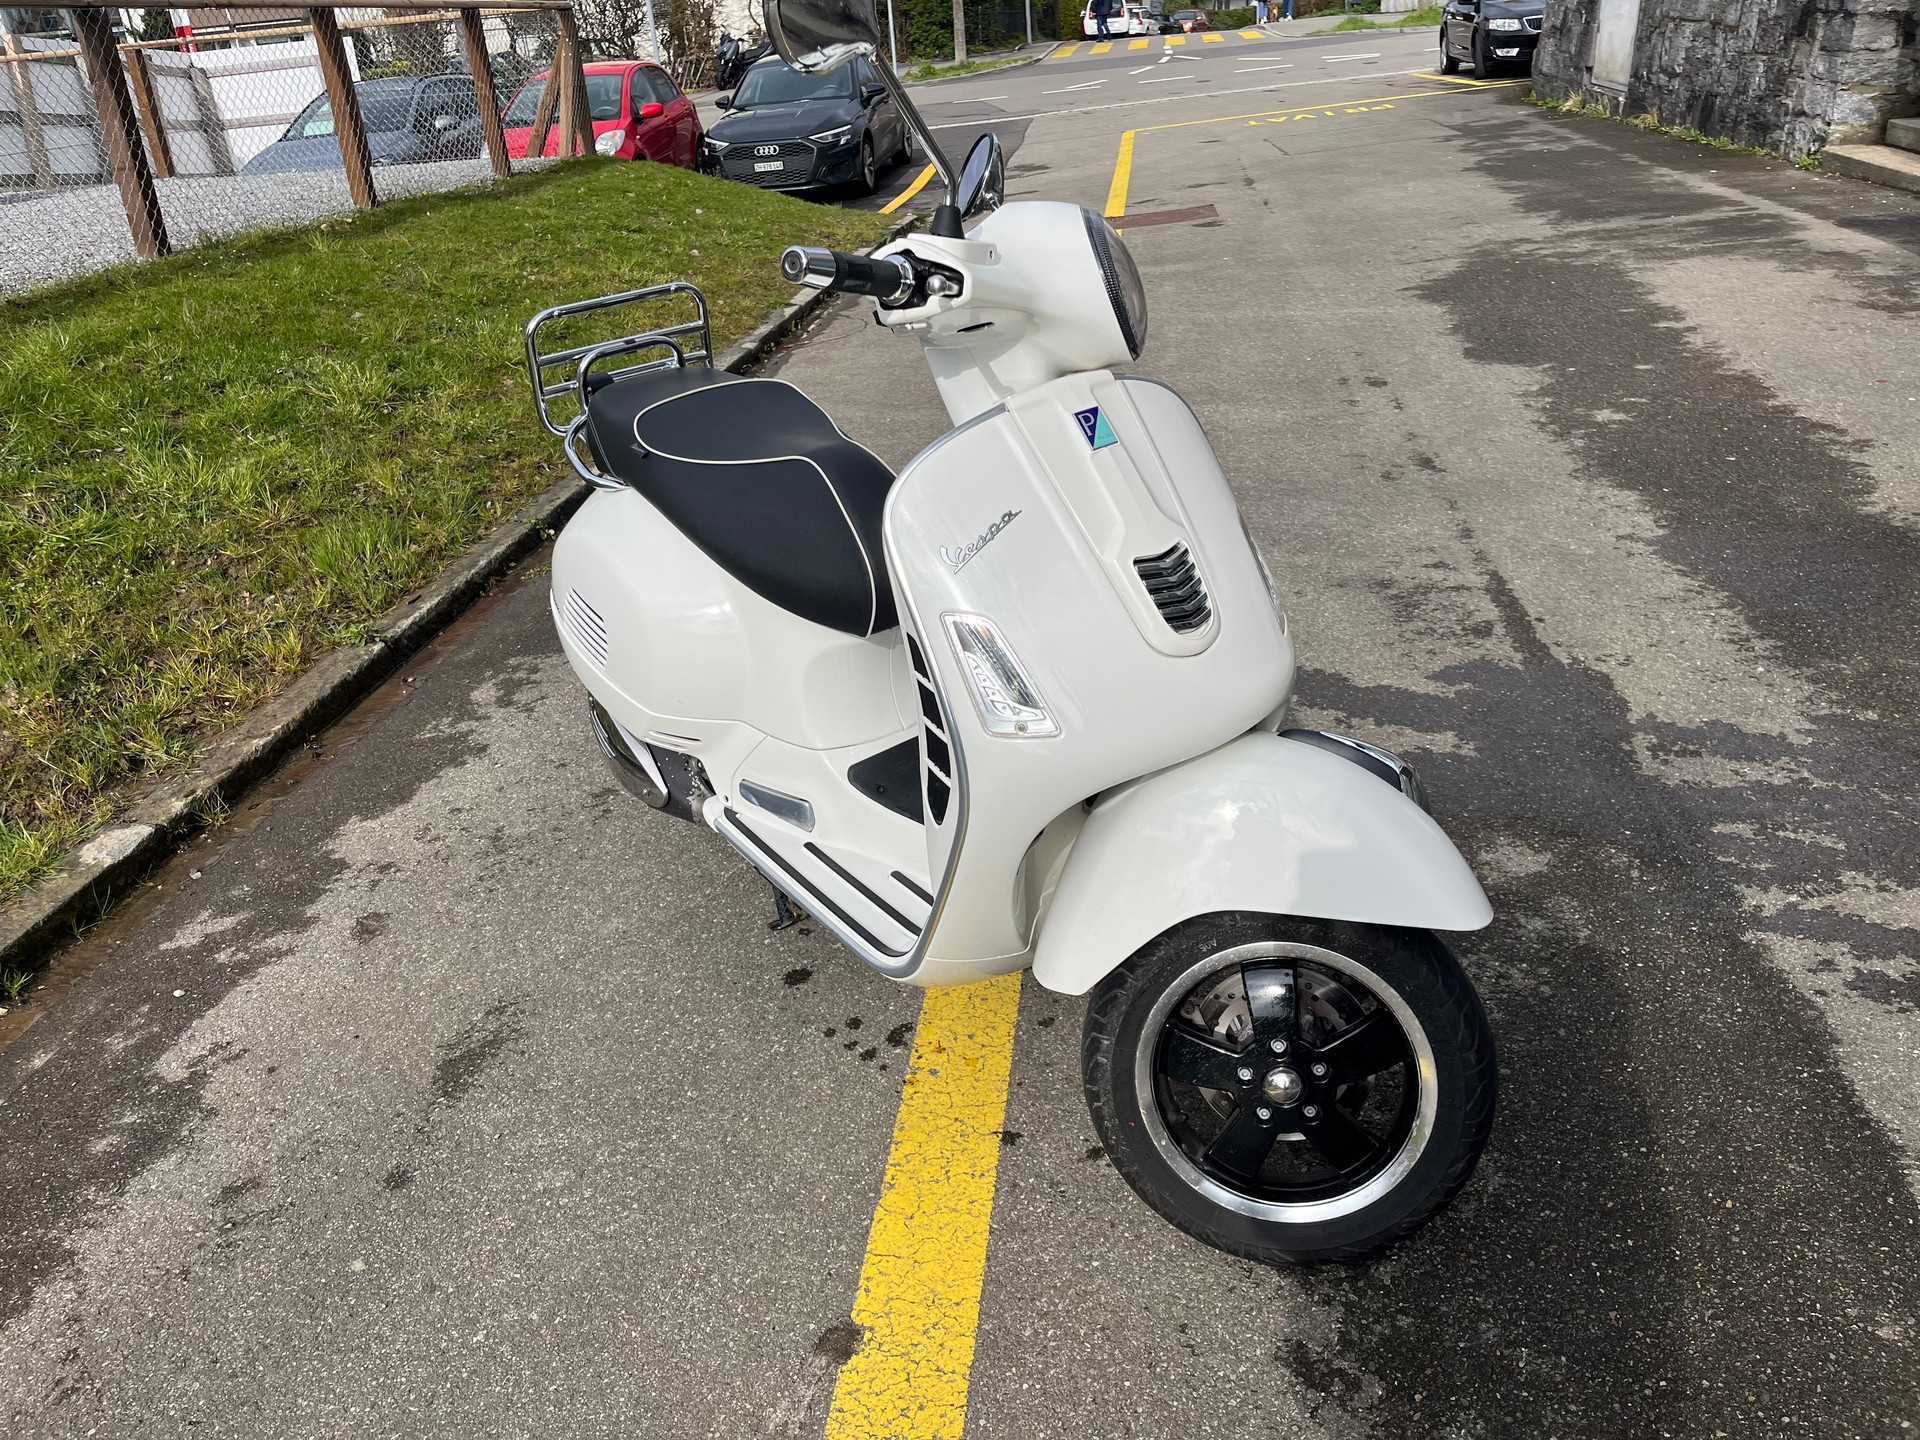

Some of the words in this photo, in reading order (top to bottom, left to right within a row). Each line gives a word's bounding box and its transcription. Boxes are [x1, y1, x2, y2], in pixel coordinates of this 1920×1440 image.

[1243, 103, 1395, 127] PRIVAT
[1077, 412, 1095, 437] P
[939, 510, 1022, 575] Vespa
